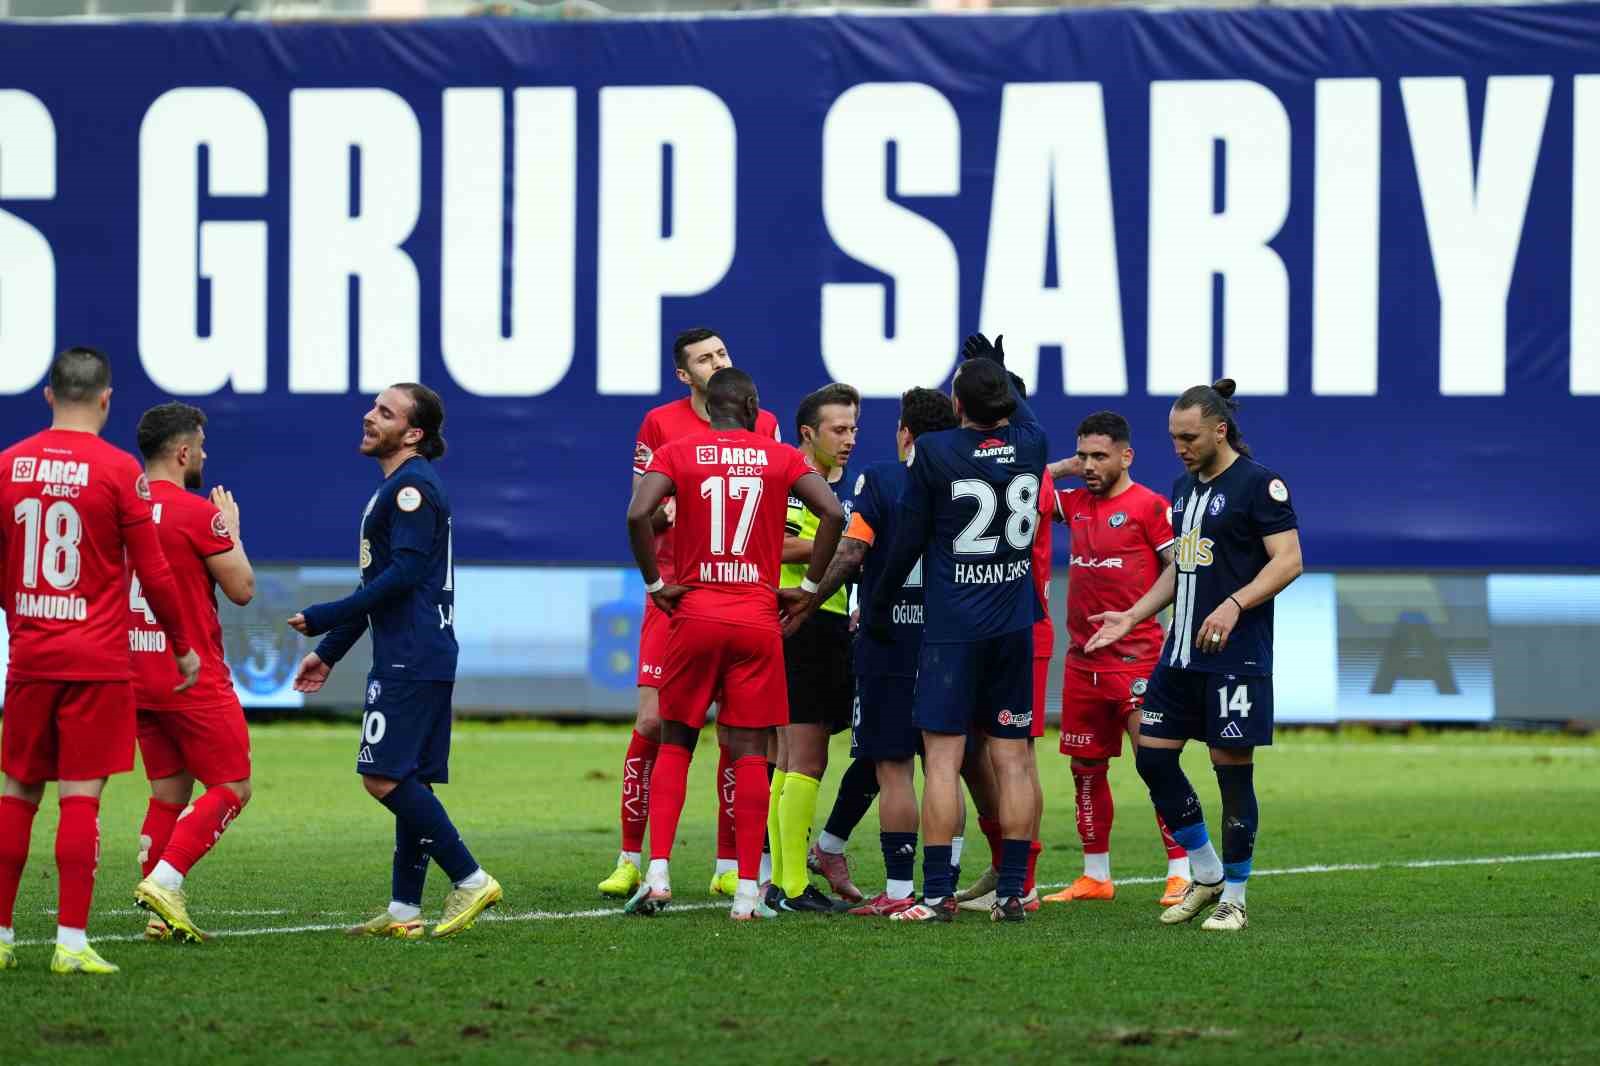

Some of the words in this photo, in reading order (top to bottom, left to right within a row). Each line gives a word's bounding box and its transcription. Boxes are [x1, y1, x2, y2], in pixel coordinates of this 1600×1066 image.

[137, 86, 738, 396] GRUP
[821, 75, 1600, 396] SARIY
[720, 448, 769, 466] ARCA
[973, 446, 1016, 458] SARIYER
[36, 459, 90, 486] ARCA
[726, 466, 763, 476] AERO
[41, 485, 81, 499] AERO
[701, 476, 764, 556] 17
[951, 473, 1040, 555] 28
[14, 498, 83, 590] 18
[1069, 554, 1123, 569] ALKAR
[954, 563, 1003, 584] HASAN
[892, 599, 924, 624] OĞUZH
[1217, 684, 1252, 718] 14
[1062, 733, 1092, 746] OTUS
